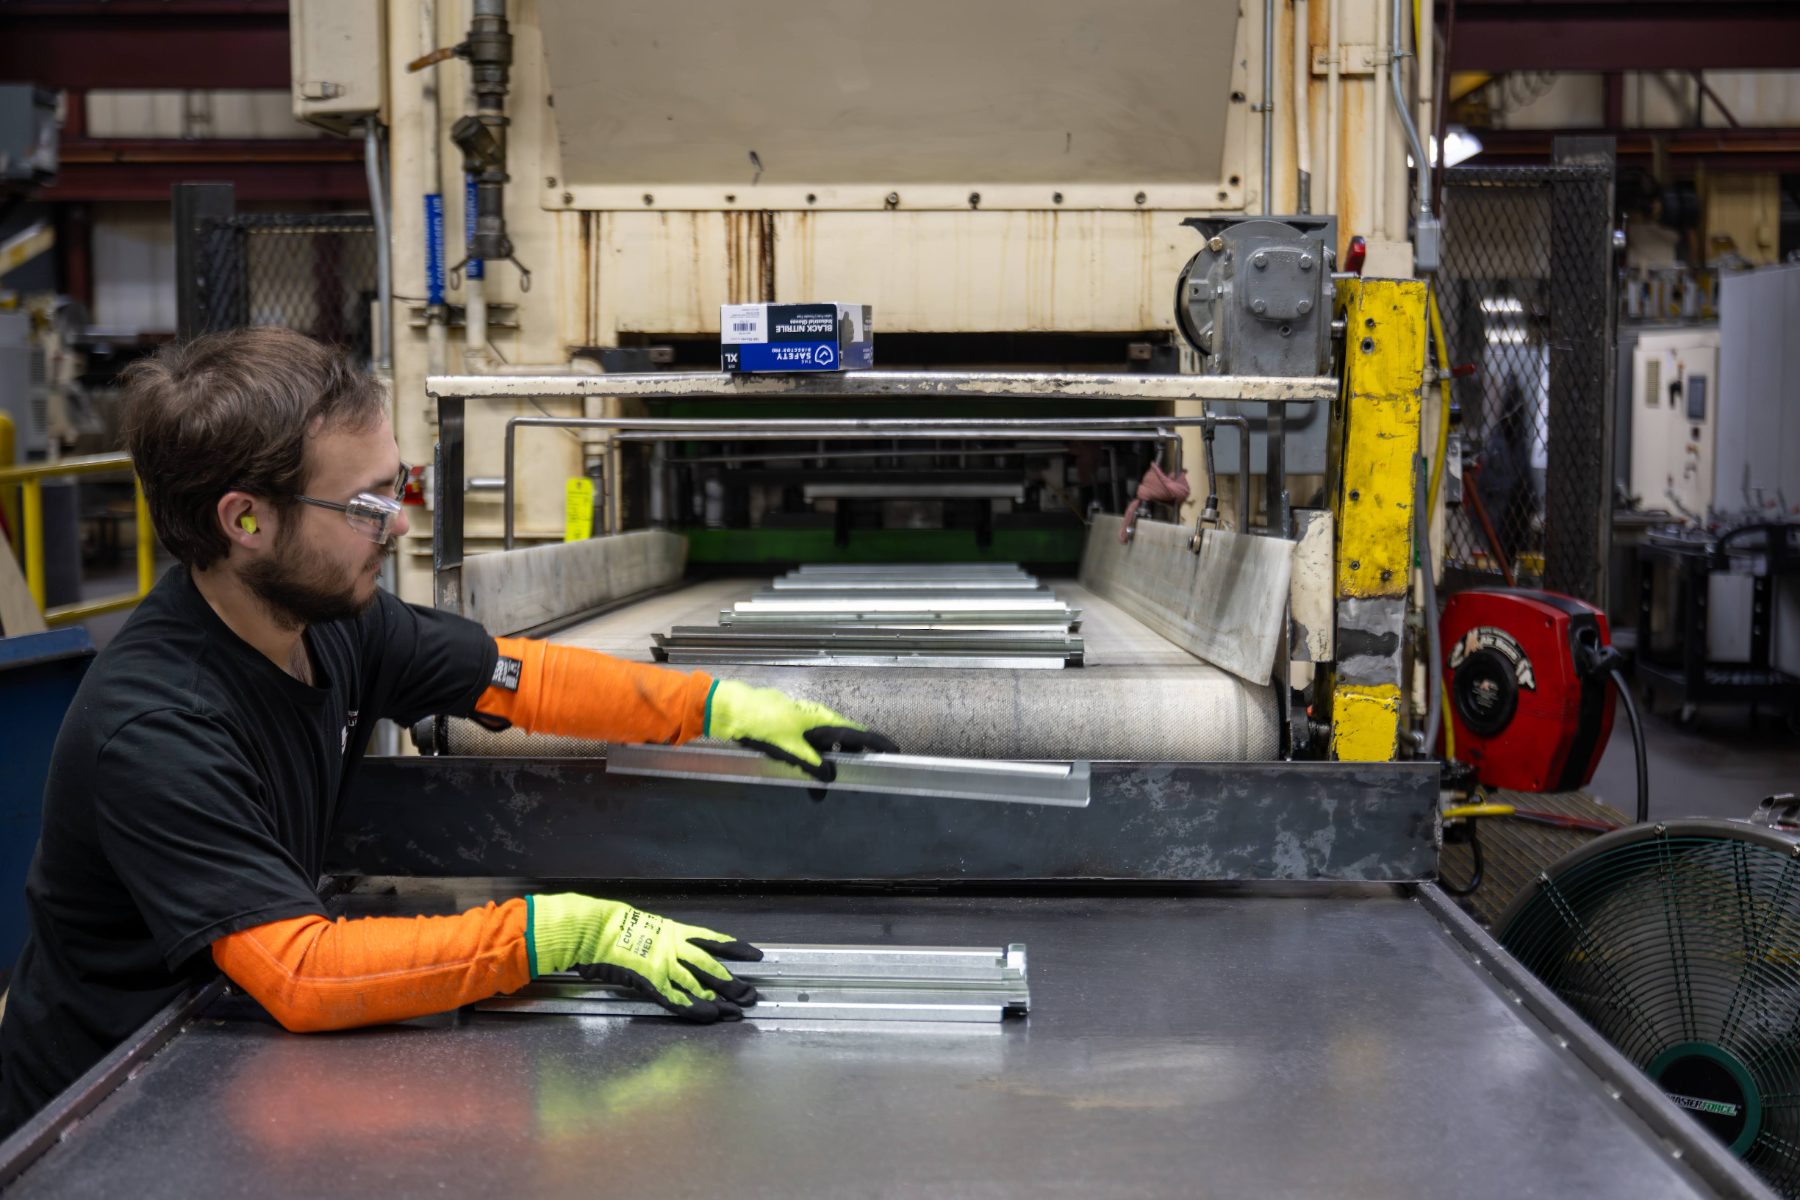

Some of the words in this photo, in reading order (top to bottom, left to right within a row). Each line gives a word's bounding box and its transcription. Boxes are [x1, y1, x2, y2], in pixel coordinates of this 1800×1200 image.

[775, 324, 806, 333] NITRILE
[806, 324, 833, 333] BLACK
[725, 353, 738, 362] XL
[776, 352, 812, 360] SAFETY
[640, 937, 653, 958] MED
